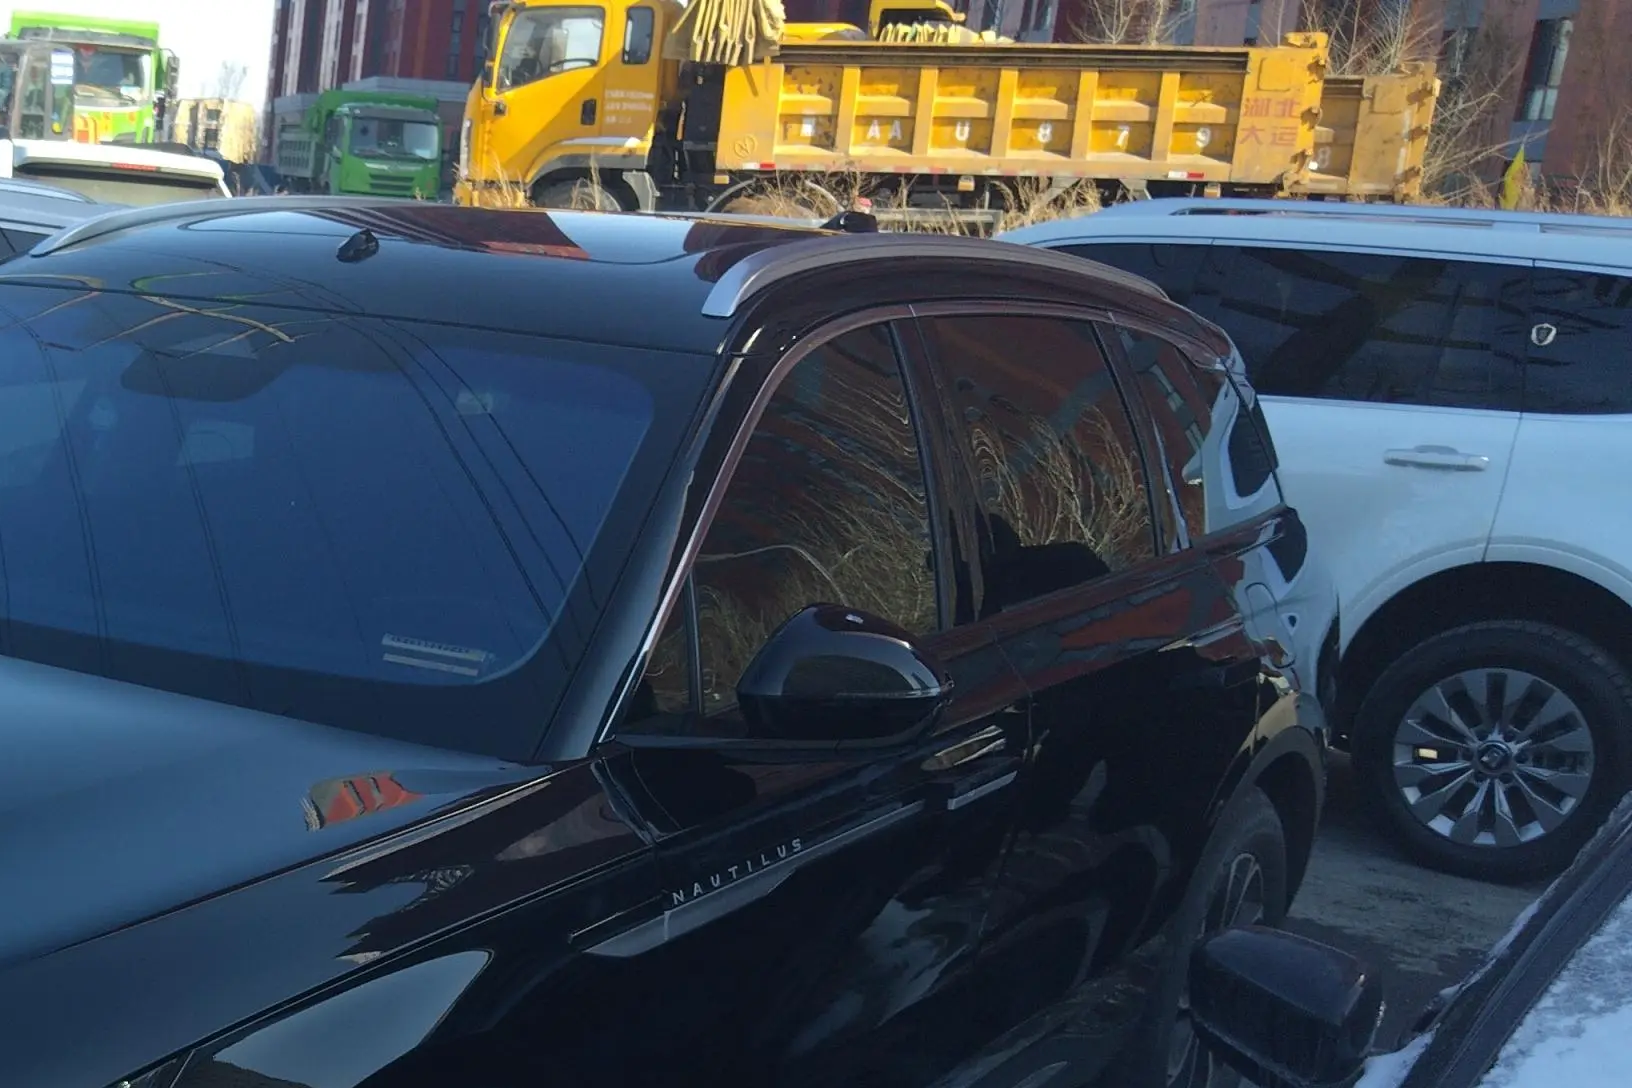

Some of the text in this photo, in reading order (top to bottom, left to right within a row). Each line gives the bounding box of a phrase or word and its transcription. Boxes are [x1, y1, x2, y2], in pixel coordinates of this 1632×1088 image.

[1244, 97, 1301, 118] 湖北
[1239, 124, 1297, 145] 大运
[672, 838, 803, 905] NAUTILUS
